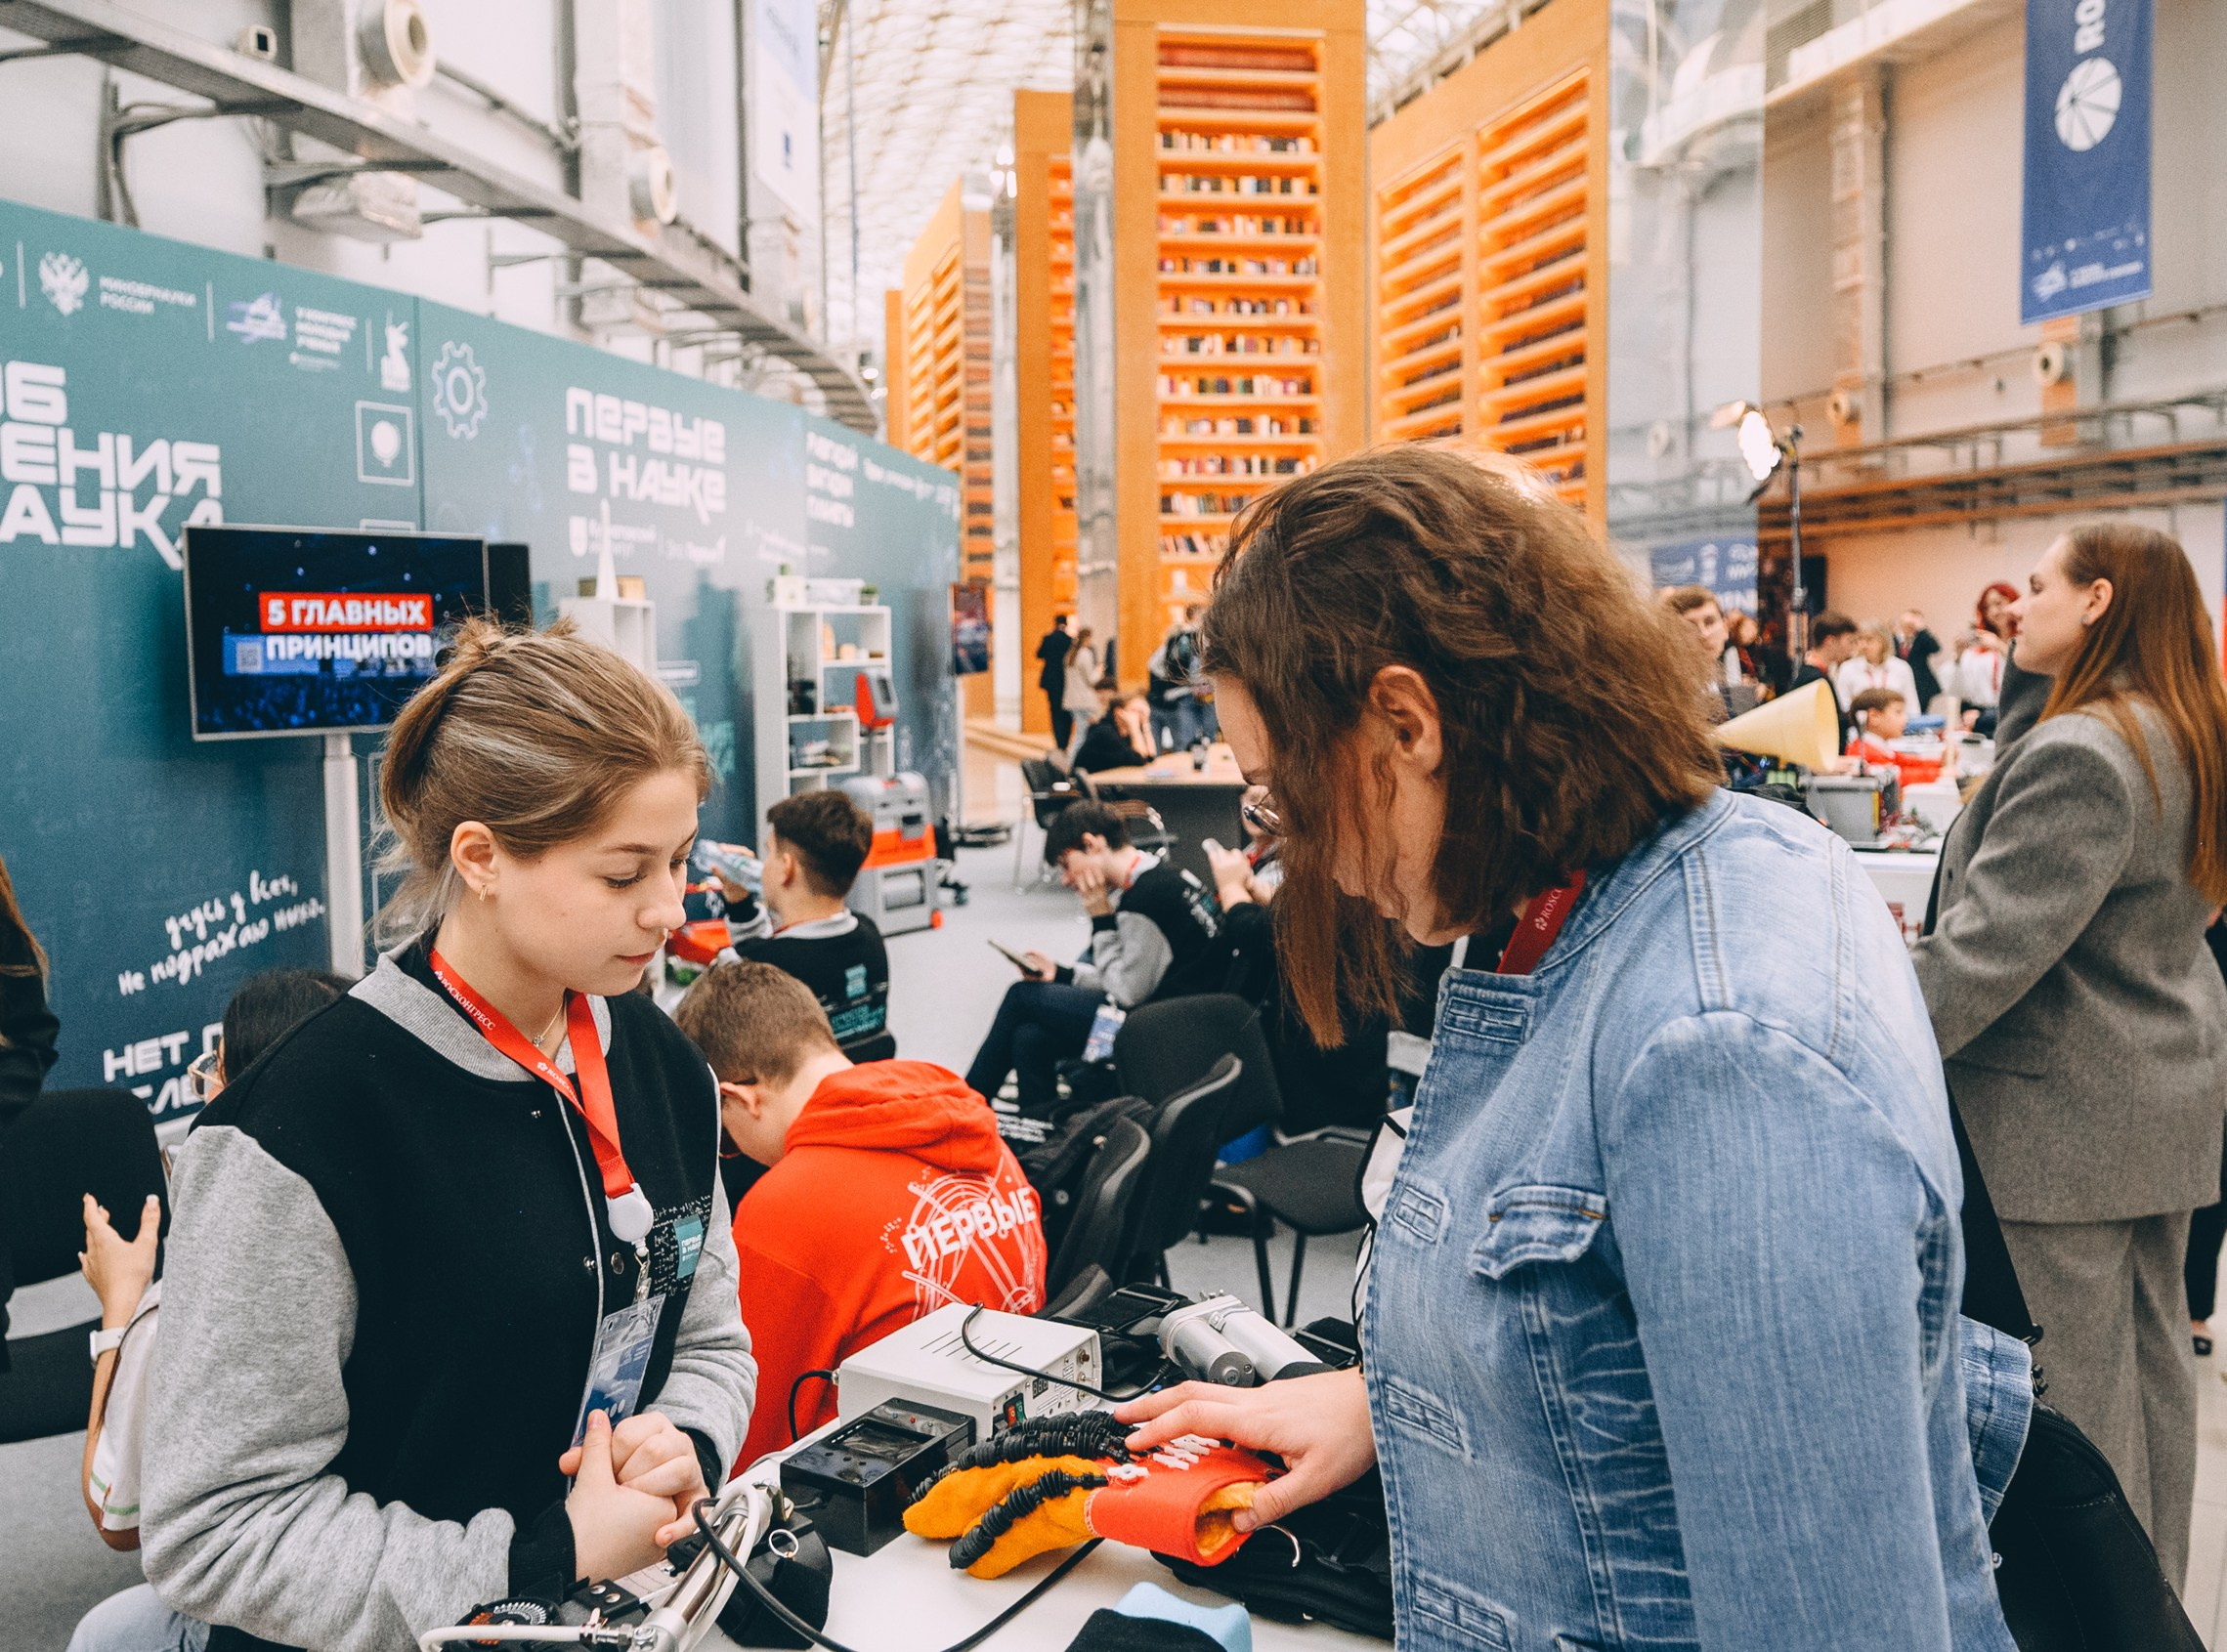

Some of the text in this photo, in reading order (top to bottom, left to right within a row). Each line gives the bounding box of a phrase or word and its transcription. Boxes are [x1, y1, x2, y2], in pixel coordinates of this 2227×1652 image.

[0, 360, 67, 426] Б
[566, 386, 726, 465] ПЕРВЫЕ
[0, 421, 223, 498] ЕНИЯ
[567, 443, 727, 526] В НАУКЕ
[267, 598, 427, 626] 5 ГЛАВНЫХ
[266, 634, 434, 662] ПРИНЦИПОВ
[442, 978, 496, 1031] РОСКОНГРЕСС
[103, 1030, 191, 1083] НЕТ
[901, 1187, 1037, 1270] ПЕРВЫЕ
